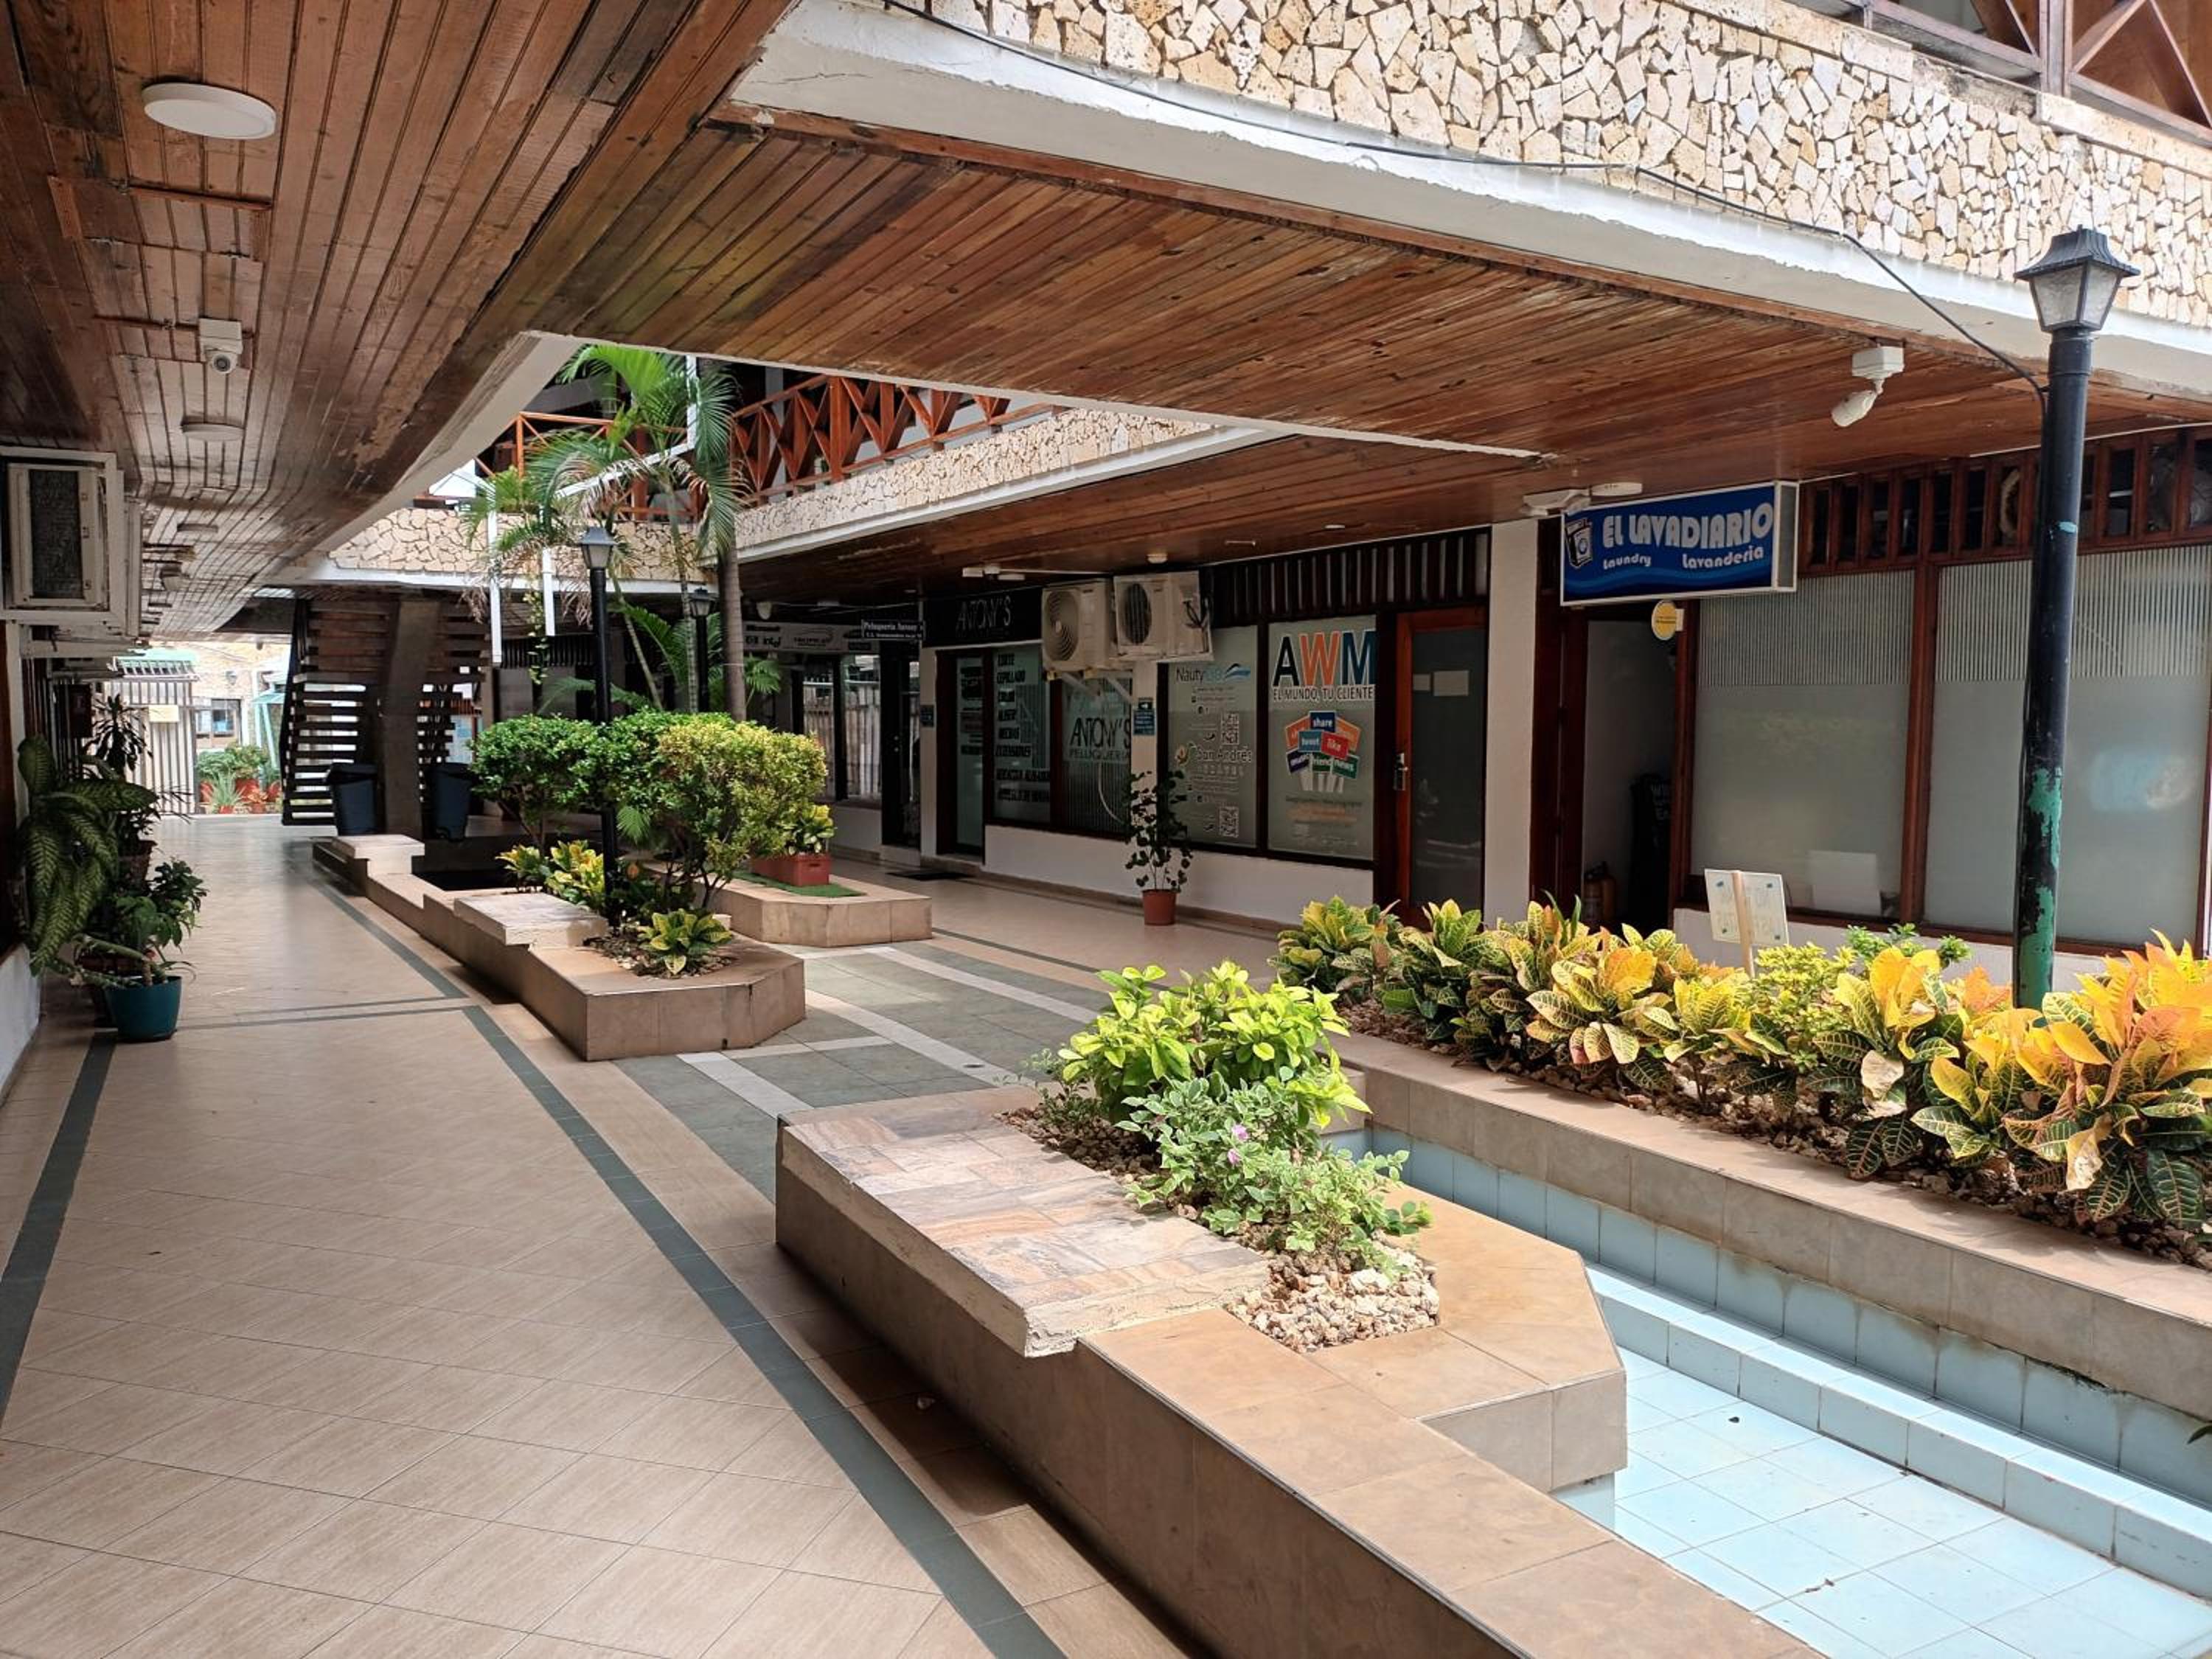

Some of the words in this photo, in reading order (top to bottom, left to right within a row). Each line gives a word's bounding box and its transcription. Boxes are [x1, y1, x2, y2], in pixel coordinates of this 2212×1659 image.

[1602, 515, 1624, 548] EL
[1628, 502, 1774, 549] LAVADIARIO
[1603, 553, 1652, 570] Laundry
[1272, 630, 1377, 686] AWM
[1322, 687, 1335, 700] TU
[1337, 686, 1374, 700] CLIENTE
[1312, 717, 1333, 727] share
